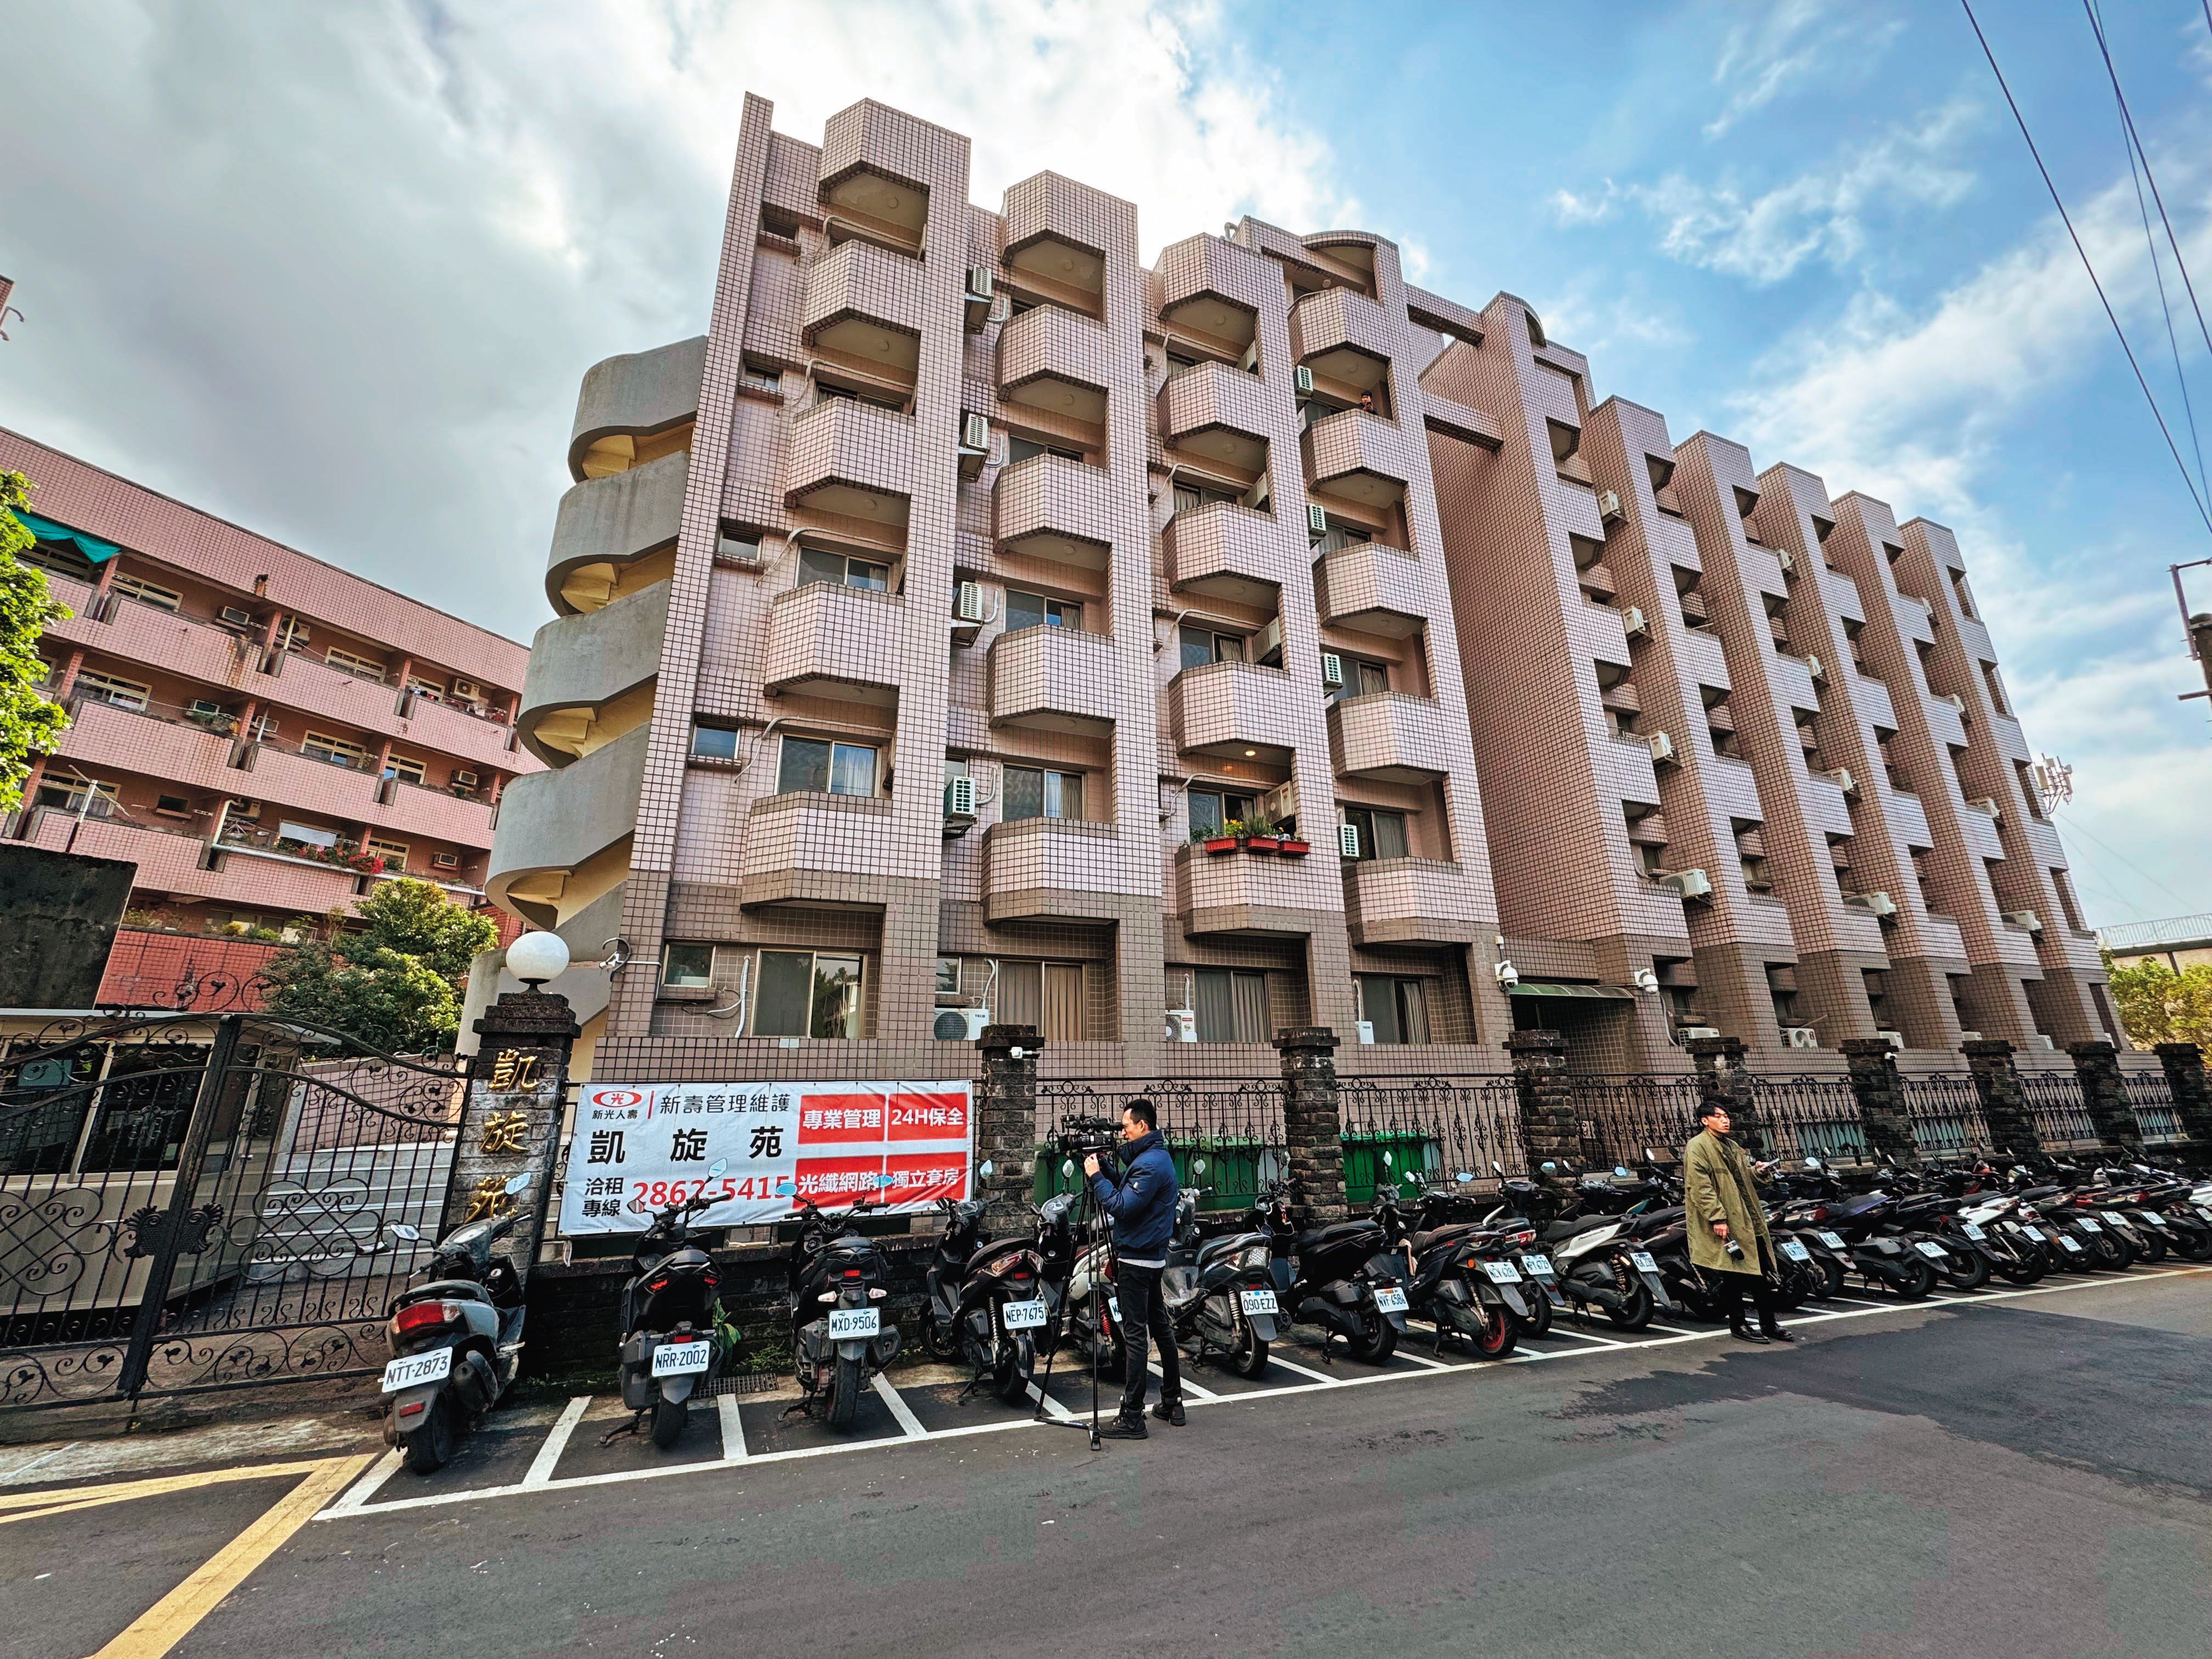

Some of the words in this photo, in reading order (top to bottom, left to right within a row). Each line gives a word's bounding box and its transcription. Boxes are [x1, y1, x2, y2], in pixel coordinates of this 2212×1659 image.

[610, 1092, 625, 1105] 光
[659, 1093, 791, 1114] 新壽管理維護
[591, 1109, 638, 1120] 新光人壽
[802, 1108, 881, 1130] 專業管理
[890, 1107, 964, 1127] 24H保全
[584, 1177, 624, 1196] 洽租
[798, 1170, 878, 1195] 光纖網路
[891, 1167, 960, 1189] 獨立套房
[581, 1199, 620, 1217] 專線
[1243, 1298, 1277, 1311] 090-EZZ
[1005, 1306, 1044, 1323] NEP-7675
[831, 1316, 877, 1333] MXD-9506
[655, 1349, 707, 1369] NRR-2002
[386, 1355, 448, 1385] NTT-2873
